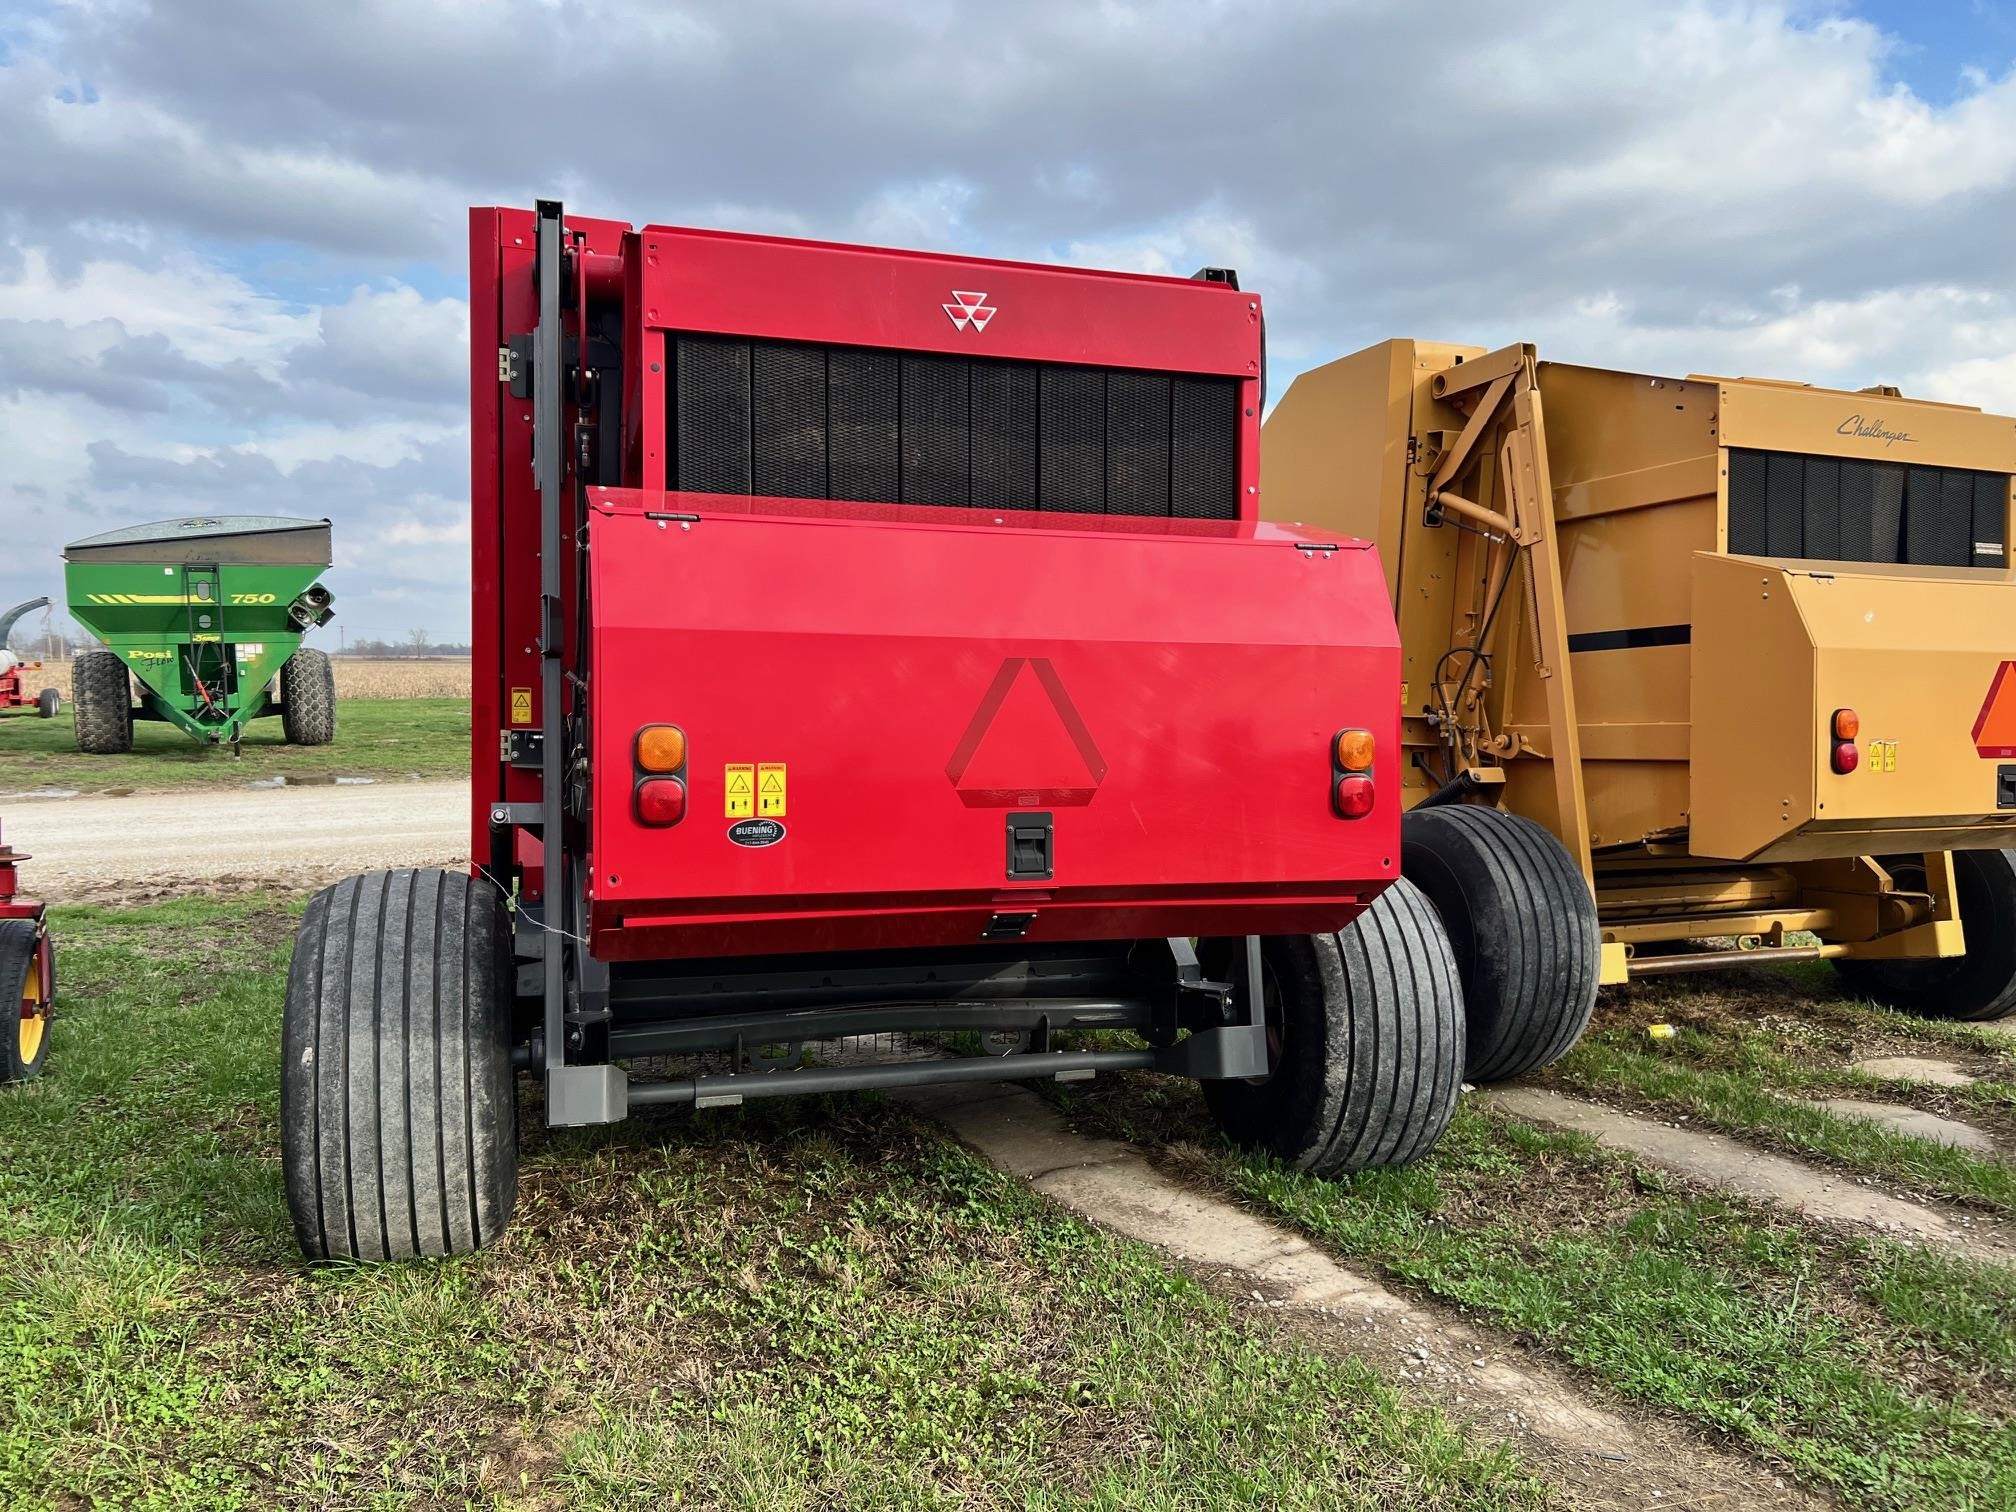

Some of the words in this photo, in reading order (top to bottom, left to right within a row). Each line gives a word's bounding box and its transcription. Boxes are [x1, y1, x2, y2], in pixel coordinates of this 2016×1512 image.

[1837, 414, 1920, 447] Challenger
[231, 593, 276, 604] 750
[128, 650, 172, 659] Posi
[736, 825, 773, 835] BUENING
